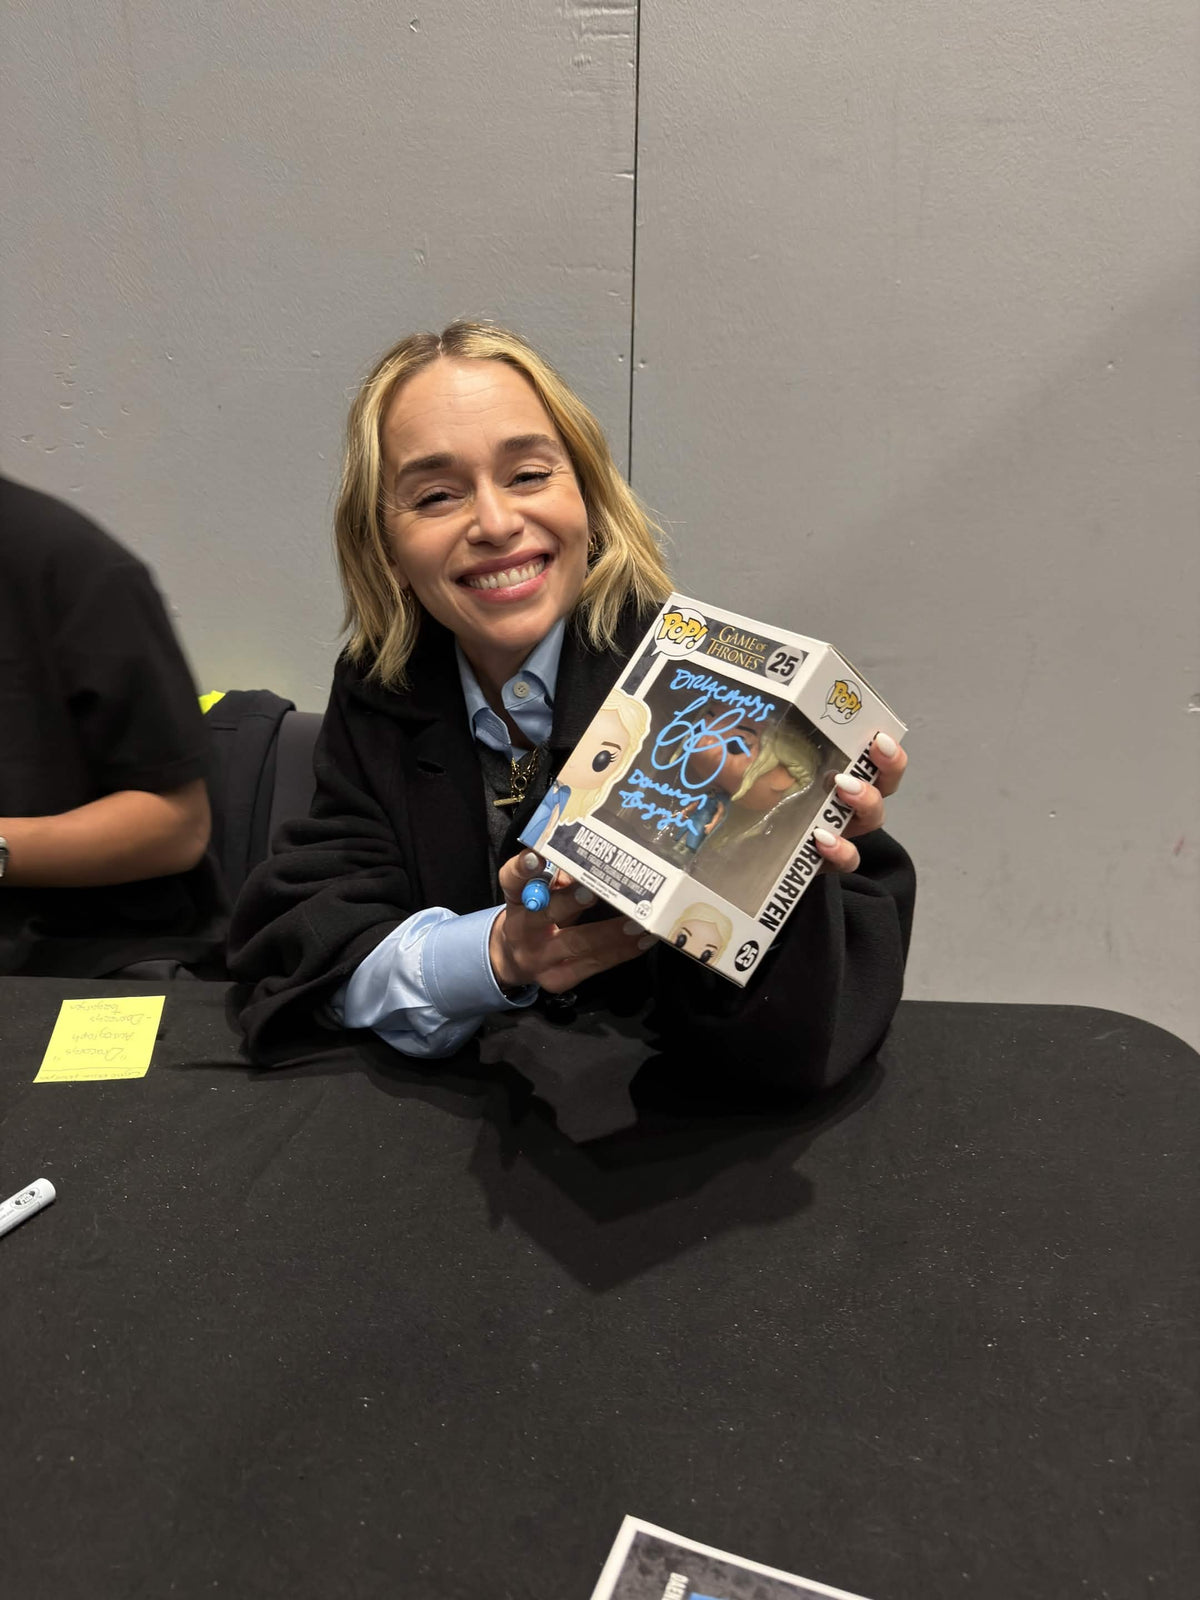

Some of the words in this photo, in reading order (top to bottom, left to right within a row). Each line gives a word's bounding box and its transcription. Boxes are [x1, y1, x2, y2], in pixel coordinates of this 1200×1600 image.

[657, 612, 710, 649] POP!
[718, 626, 758, 650] GAME
[706, 638, 765, 670] THRONES
[767, 652, 799, 677] 25
[828, 680, 863, 720] POP!
[573, 826, 617, 863] DAENERYS
[611, 849, 664, 894] TARGARYEN
[759, 826, 825, 932] ARGARYEN
[735, 943, 758, 968] 25
